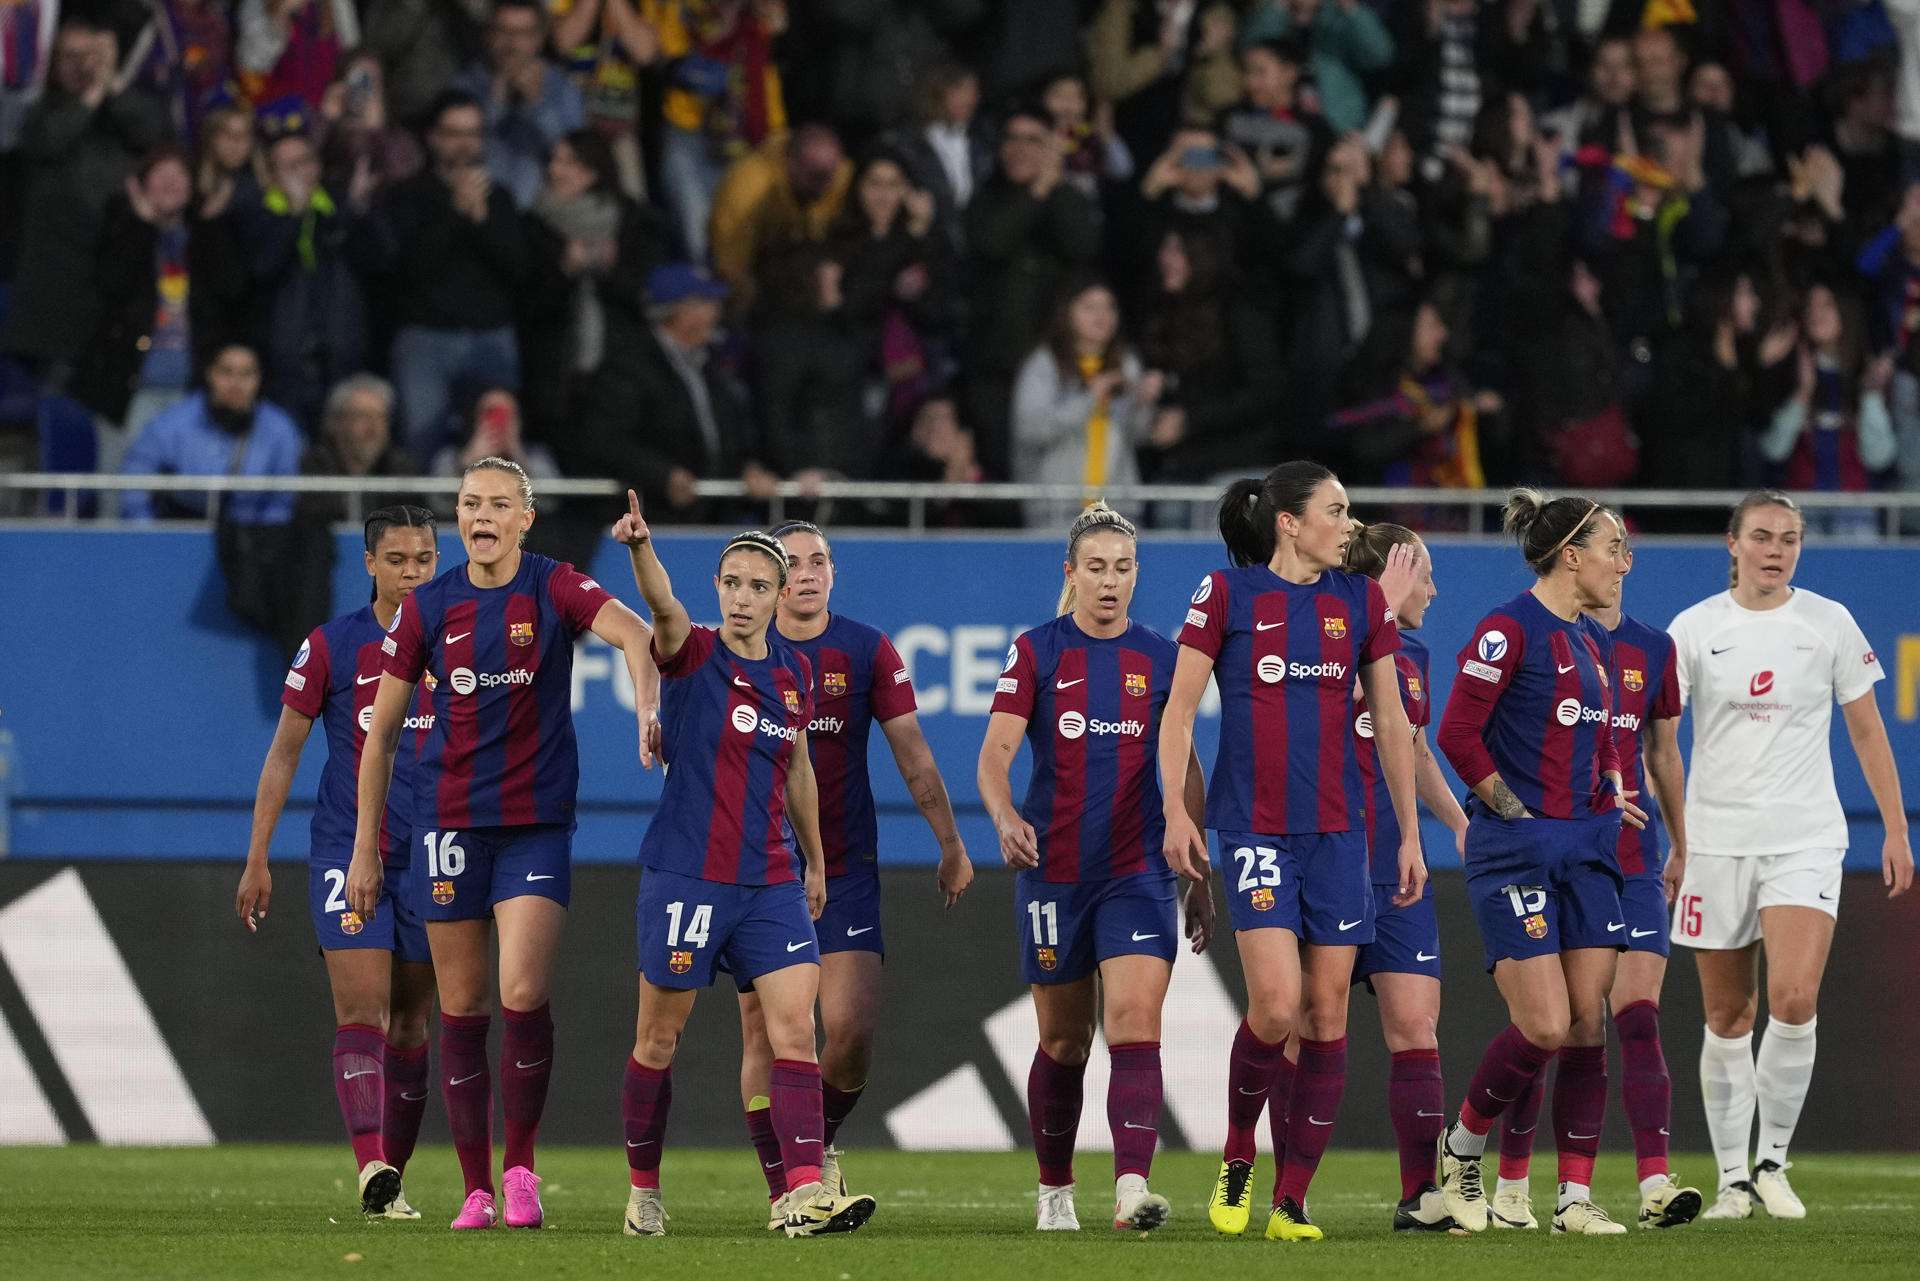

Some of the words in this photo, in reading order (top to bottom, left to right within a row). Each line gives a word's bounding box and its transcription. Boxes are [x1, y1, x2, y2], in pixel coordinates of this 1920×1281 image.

[479, 669, 534, 688] Spotify
[1289, 662, 1346, 680] Spotify
[807, 717, 844, 734] otify
[1089, 718, 1145, 738] Spotify
[1611, 713, 1641, 731] otify
[1749, 712, 1770, 723] Vest
[424, 831, 466, 877] 16
[1233, 846, 1282, 893] 23
[324, 868, 346, 913] 2
[1500, 884, 1547, 918] 15
[666, 901, 714, 949] 14
[1027, 900, 1058, 946] 11
[1681, 894, 1703, 937] 15
